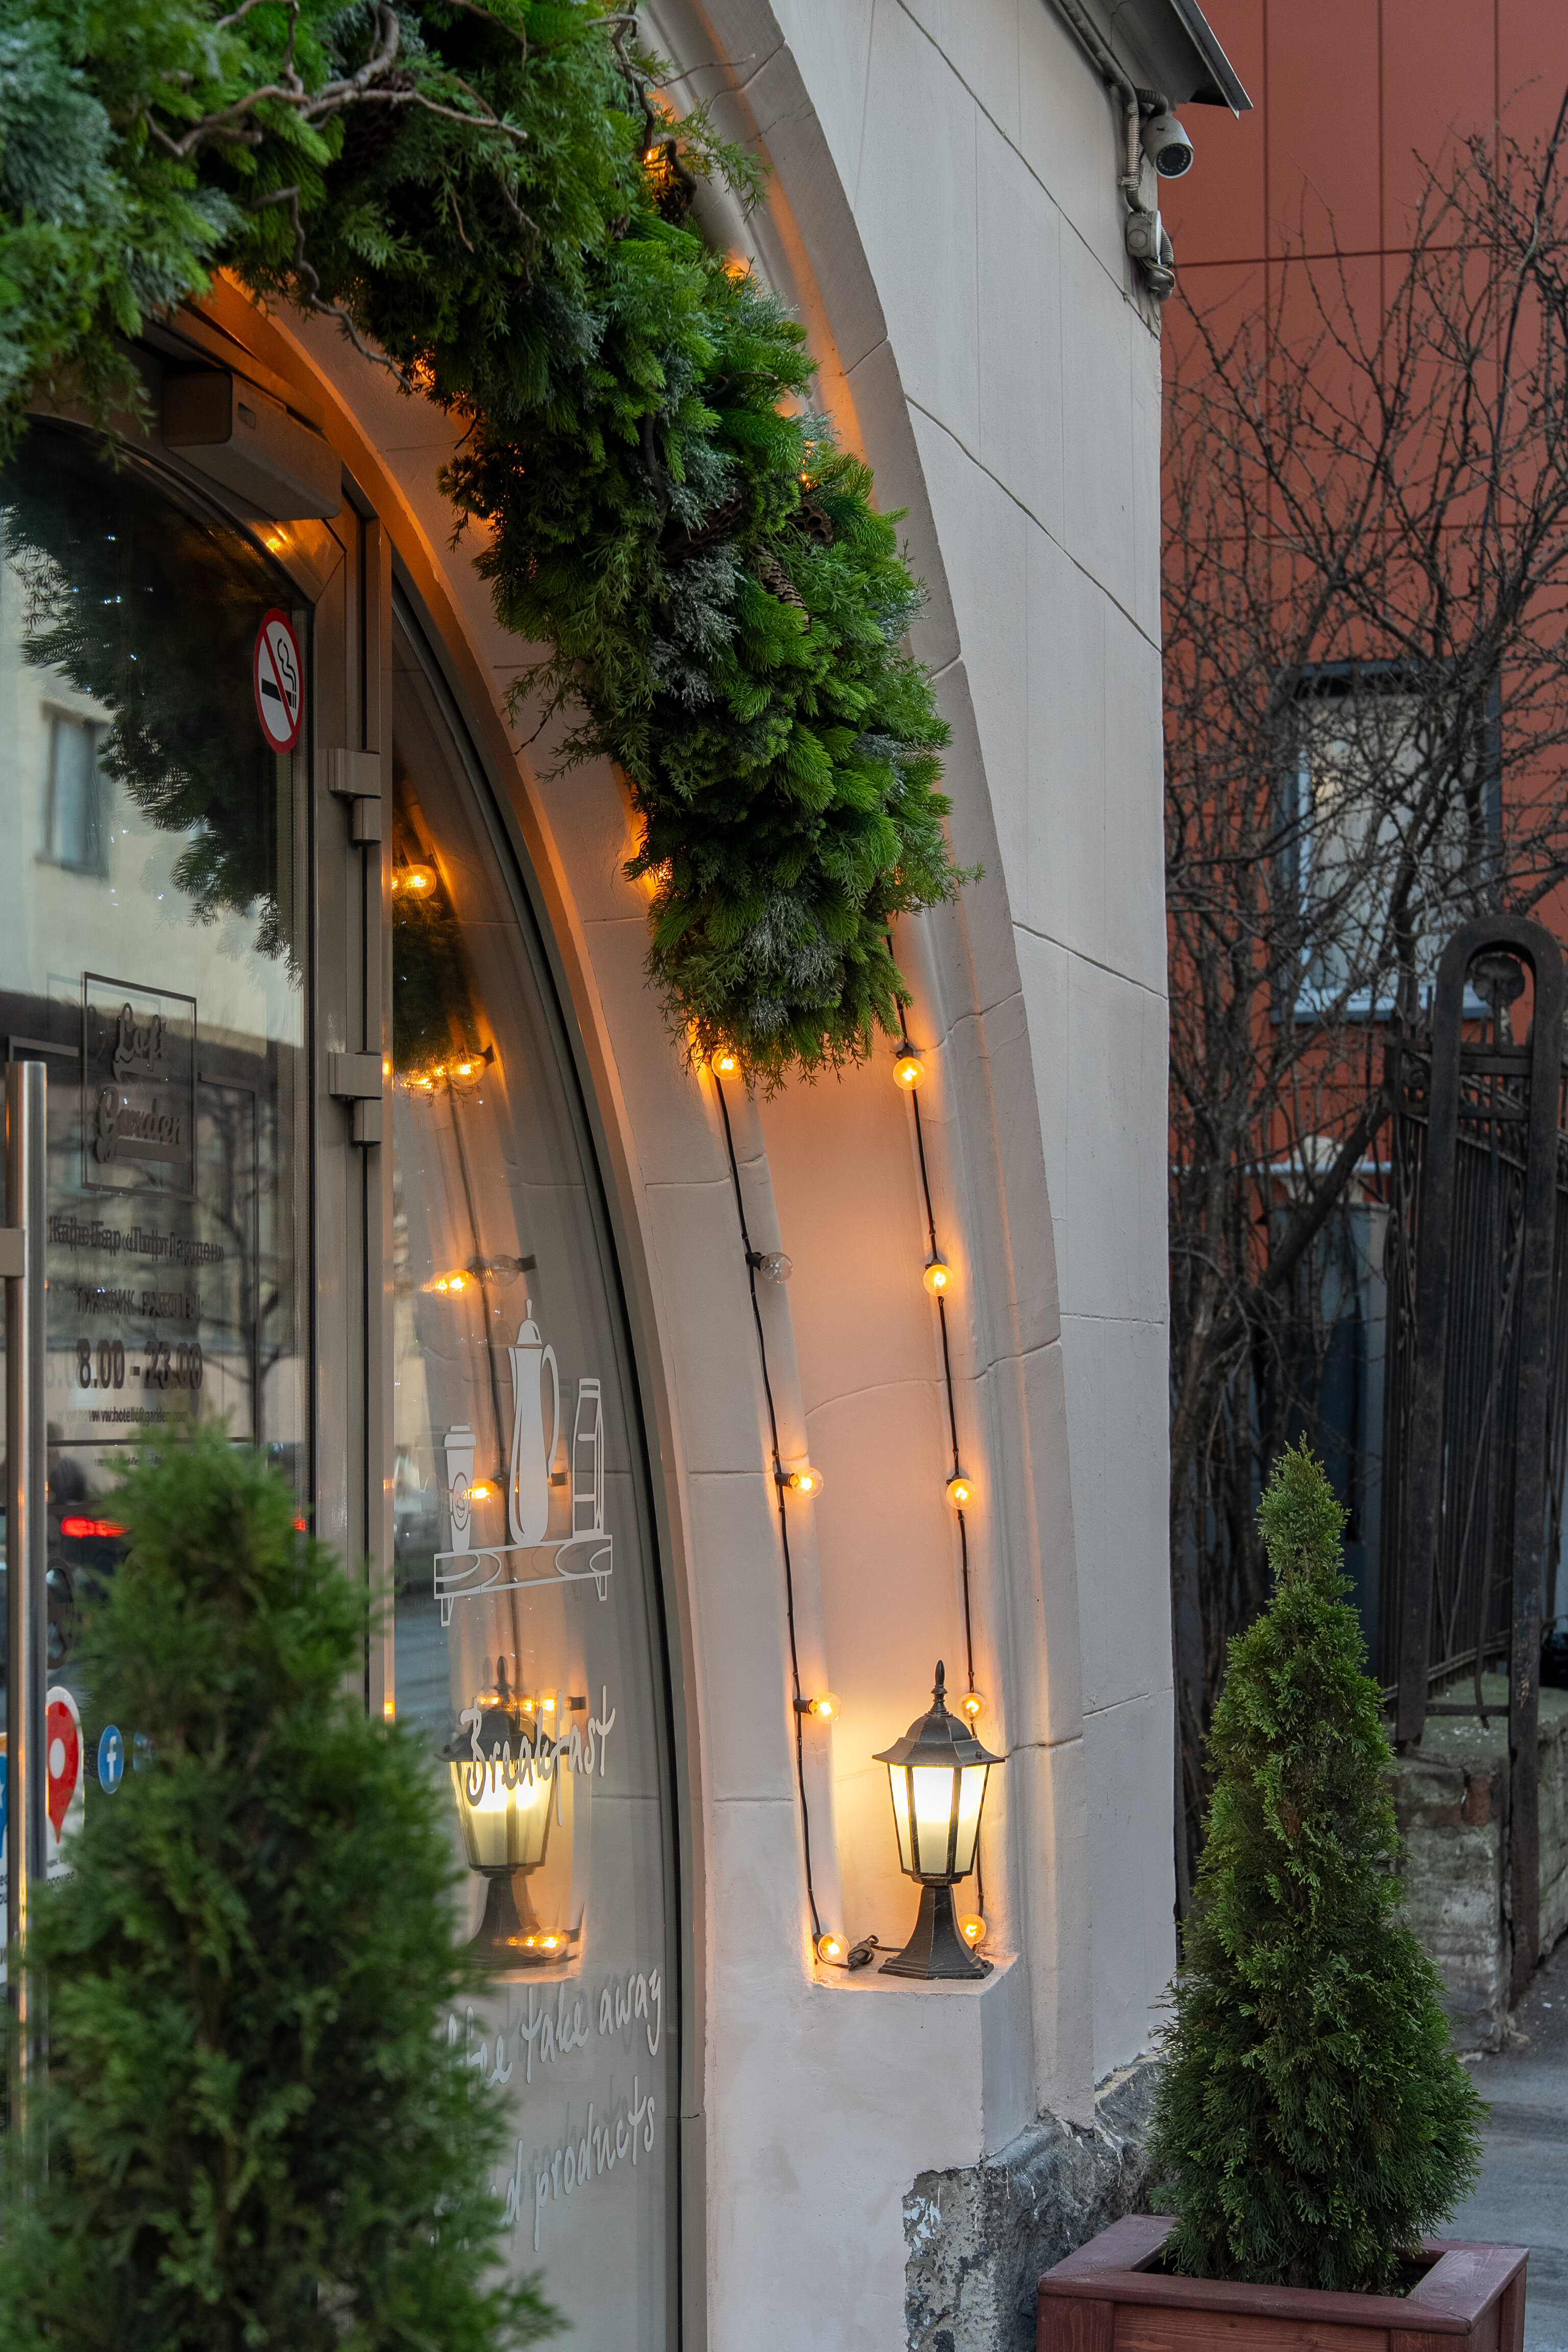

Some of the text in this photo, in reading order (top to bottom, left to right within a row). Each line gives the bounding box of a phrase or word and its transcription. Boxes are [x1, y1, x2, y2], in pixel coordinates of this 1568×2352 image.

[77, 1338, 125, 1389] 8.00
[144, 1340, 203, 1390] 23.00
[460, 1684, 616, 1827] Breakfast
[521, 1981, 589, 2085] take
[599, 1968, 661, 2056] away
[534, 2075, 655, 2253] products
